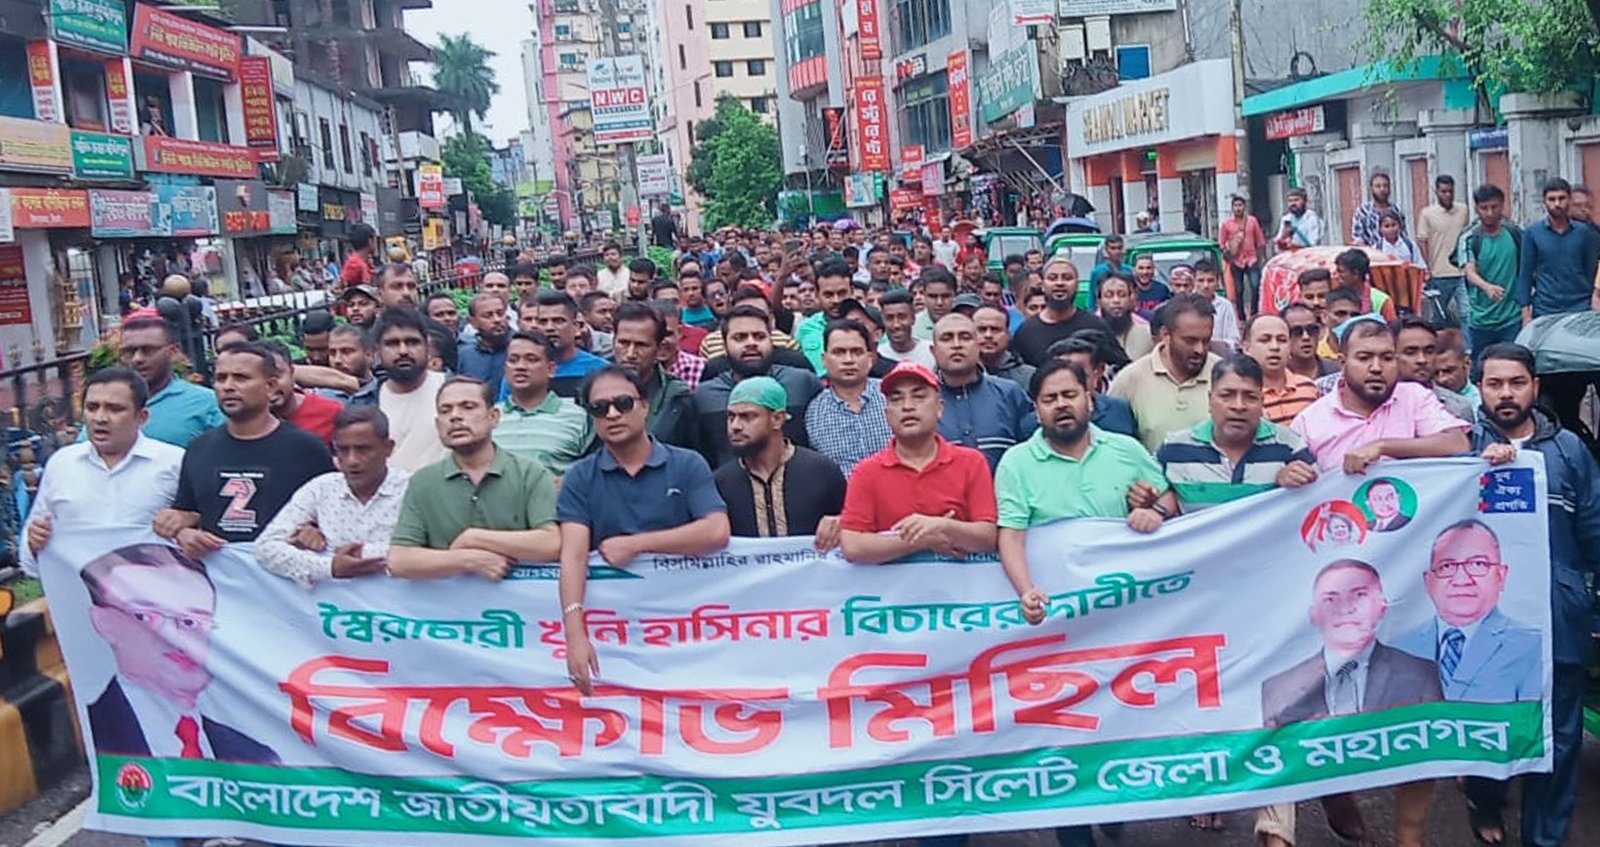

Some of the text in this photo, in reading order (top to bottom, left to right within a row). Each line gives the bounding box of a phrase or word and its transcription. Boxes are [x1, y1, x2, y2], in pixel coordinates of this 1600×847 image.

[595, 90, 642, 105] NWC
[642, 604, 831, 648] হাসিনার
[278, 632, 1226, 758] বিক্ষোভ মিছিল
[166, 717, 1511, 829] বাংলাদেশ জাতীয়তাবাদী যুবদল সিলেট জেলা ও মহানগর
